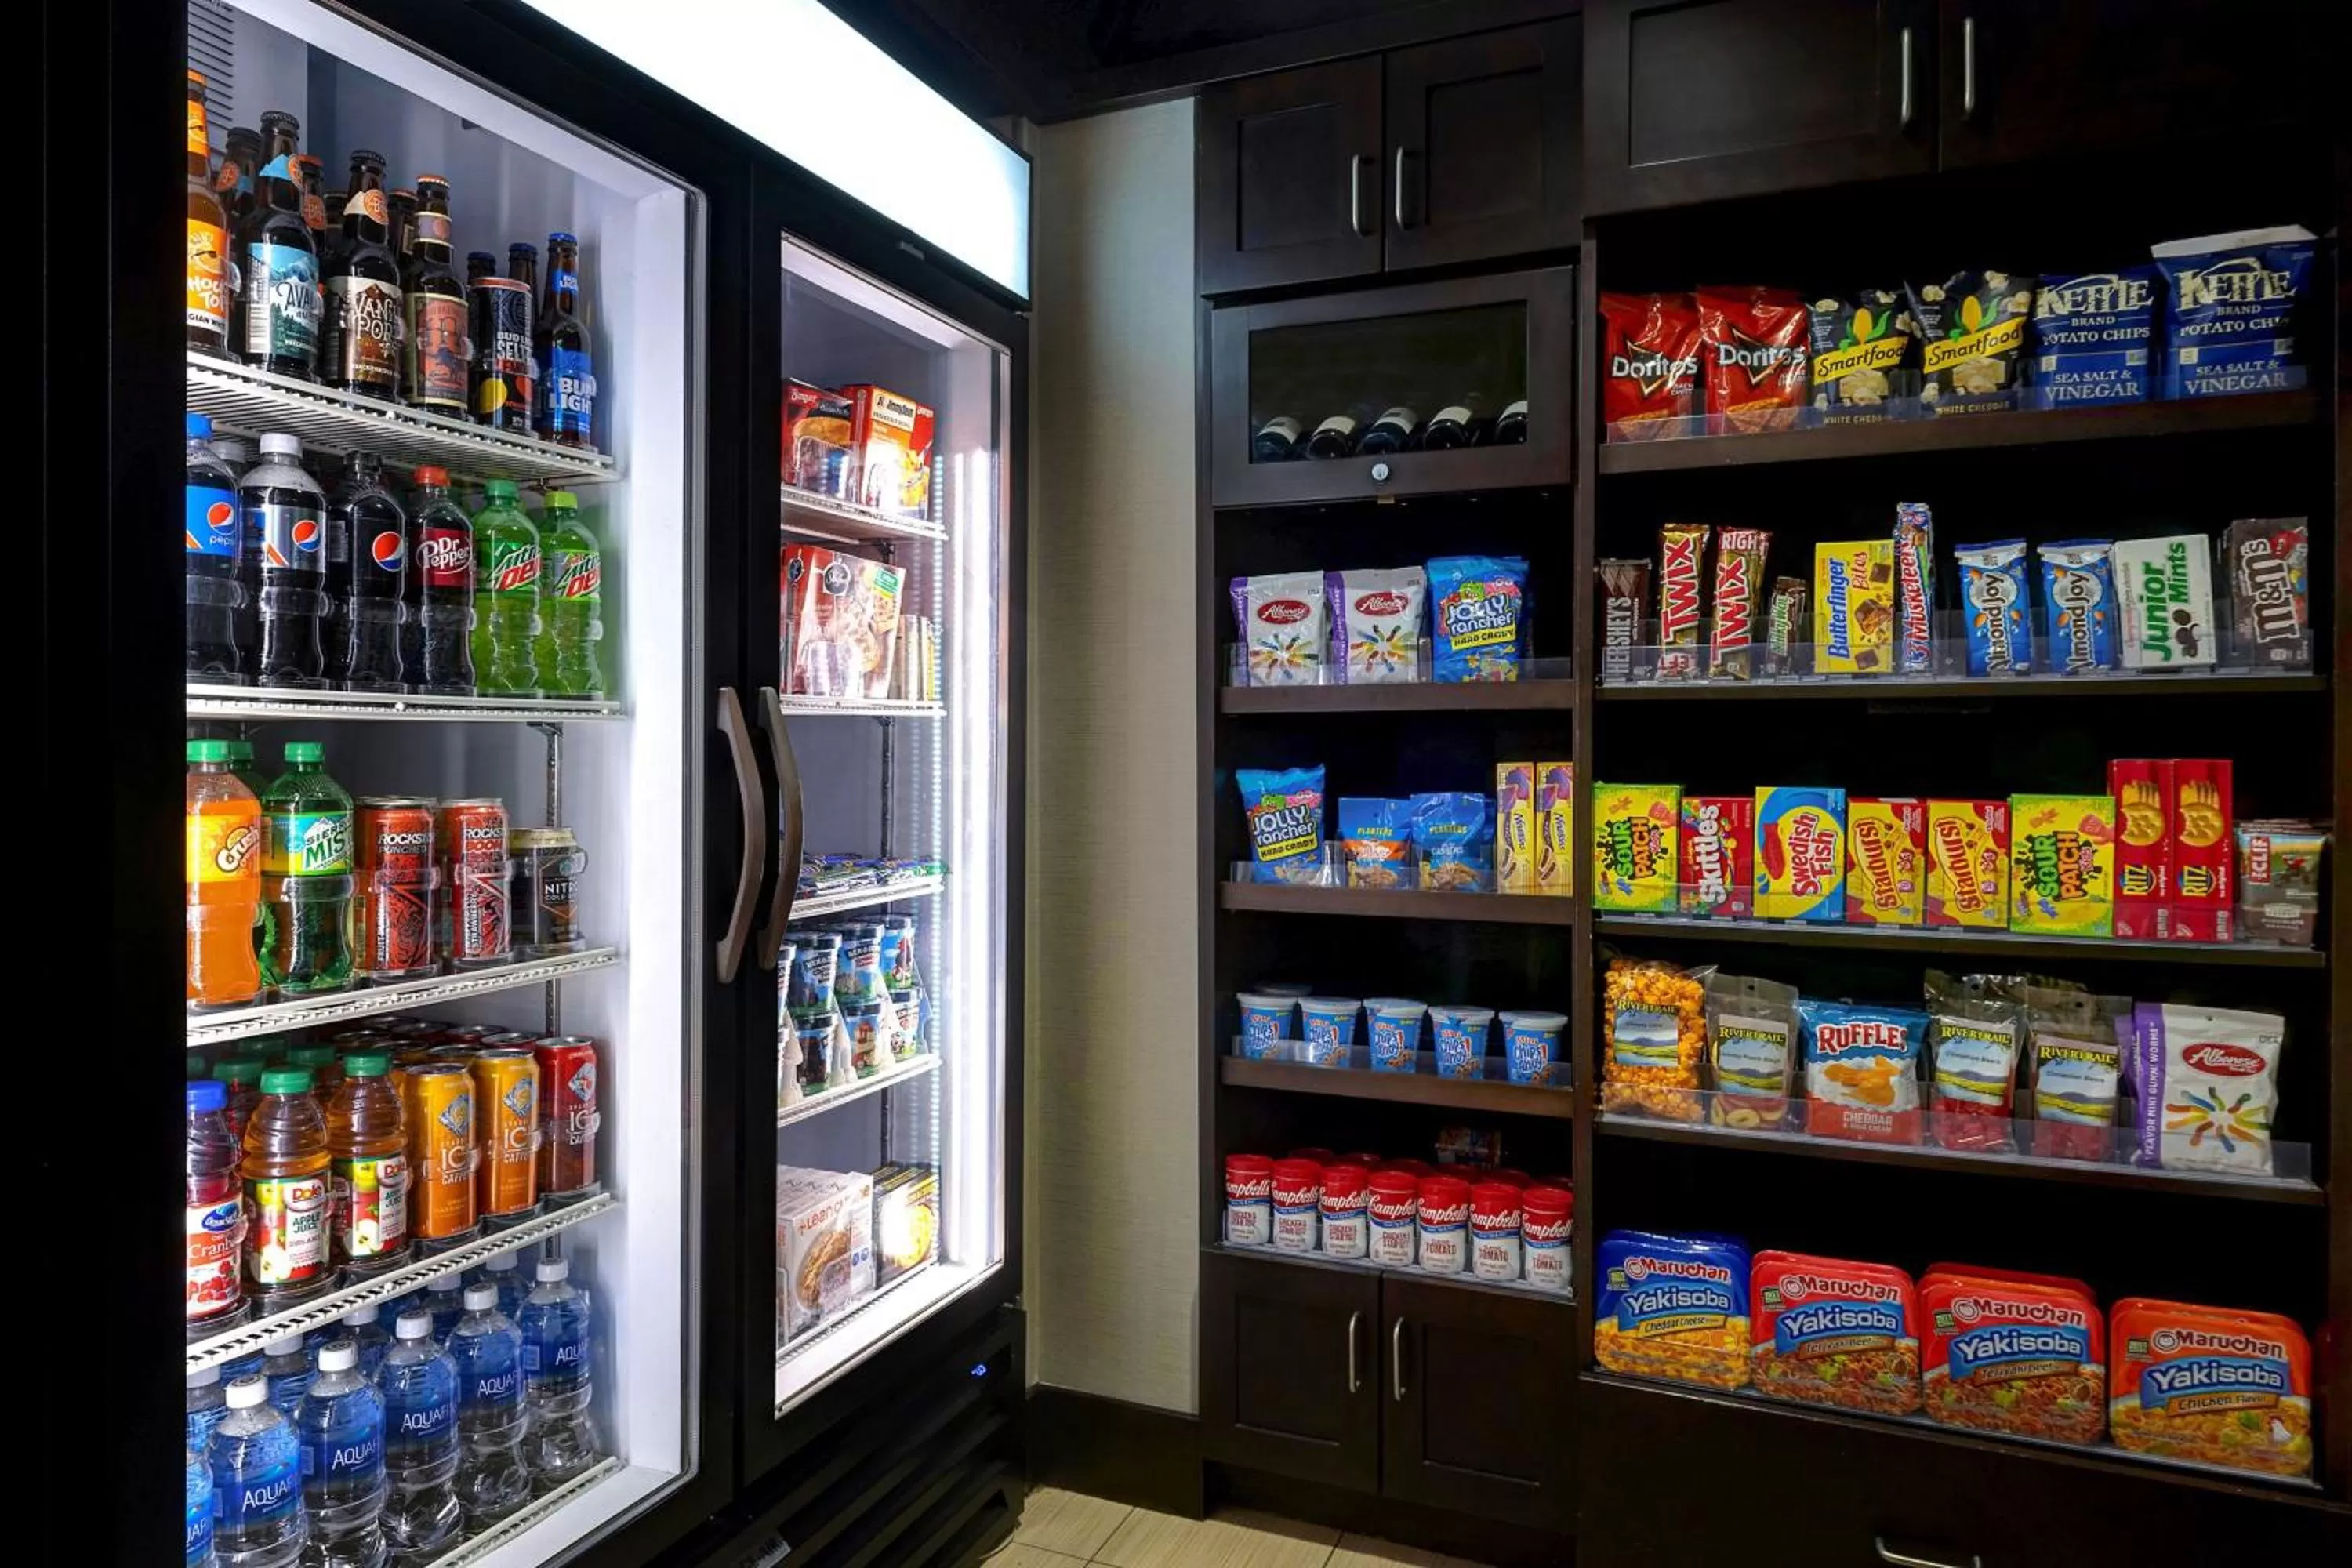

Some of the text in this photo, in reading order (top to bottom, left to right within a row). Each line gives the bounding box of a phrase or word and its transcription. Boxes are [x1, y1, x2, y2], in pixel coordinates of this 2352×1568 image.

[2033, 274, 2154, 321] KETTLE
[2174, 257, 2298, 314] KETTLE
[2071, 315, 2116, 327] BRAND
[2217, 304, 2261, 316] BRAND
[1928, 325, 2020, 366] Smartfood
[2102, 327, 2150, 340] CHIPS
[1612, 355, 1698, 379] Doritos
[1719, 344, 1806, 366] Doritos
[2196, 365, 2223, 377] SEA
[2227, 361, 2263, 373] SALT
[2054, 369, 2132, 384] SEA SALT &
[2184, 372, 2288, 396] VINEGAR
[2045, 383, 2140, 402] VINEGAR
[423, 539, 470, 570] Pepper
[439, 536, 459, 552] Dr
[1851, 551, 1870, 591] Bites
[2166, 542, 2189, 604] Mints
[1661, 536, 1700, 643] TWIX
[1981, 574, 2007, 604] Joy
[2064, 572, 2091, 604] Joy
[1447, 593, 1505, 624] JOLLY
[1711, 556, 1751, 666] TWIX
[1828, 558, 1850, 659] Butterfinger
[2140, 561, 2172, 662] Junior
[1450, 612, 1513, 636] rancher
[1253, 806, 1307, 835] JOLLY
[1256, 822, 1314, 846] rancher
[304, 830, 349, 869] MIS
[1613, 820, 1633, 877] SOUR
[1631, 817, 1656, 879] PATCH
[1789, 812, 1820, 898] Swedish
[1810, 829, 1837, 878] Fish
[2251, 836, 2269, 870] CLIF
[2034, 837, 2060, 898] SOUR
[2055, 831, 2088, 900] PATCH
[2123, 864, 2148, 895] RITZ
[2182, 865, 2207, 897] RITZ
[2040, 1046, 2116, 1065] RIVERTRAIL
[1641, 1257, 1730, 1282] Maruchan
[1626, 1287, 1730, 1315] Yakisoba
[1797, 1276, 1899, 1301] Maruchan
[1784, 1307, 1897, 1338] Yakisoba
[1974, 1299, 2083, 1326] Maruchan
[1958, 1332, 2082, 1362] Yakisoba
[2176, 1330, 2284, 1359] Maruchan
[2153, 1363, 2282, 1390] Yakisoba
[2179, 1396, 2233, 1410] Chicken
